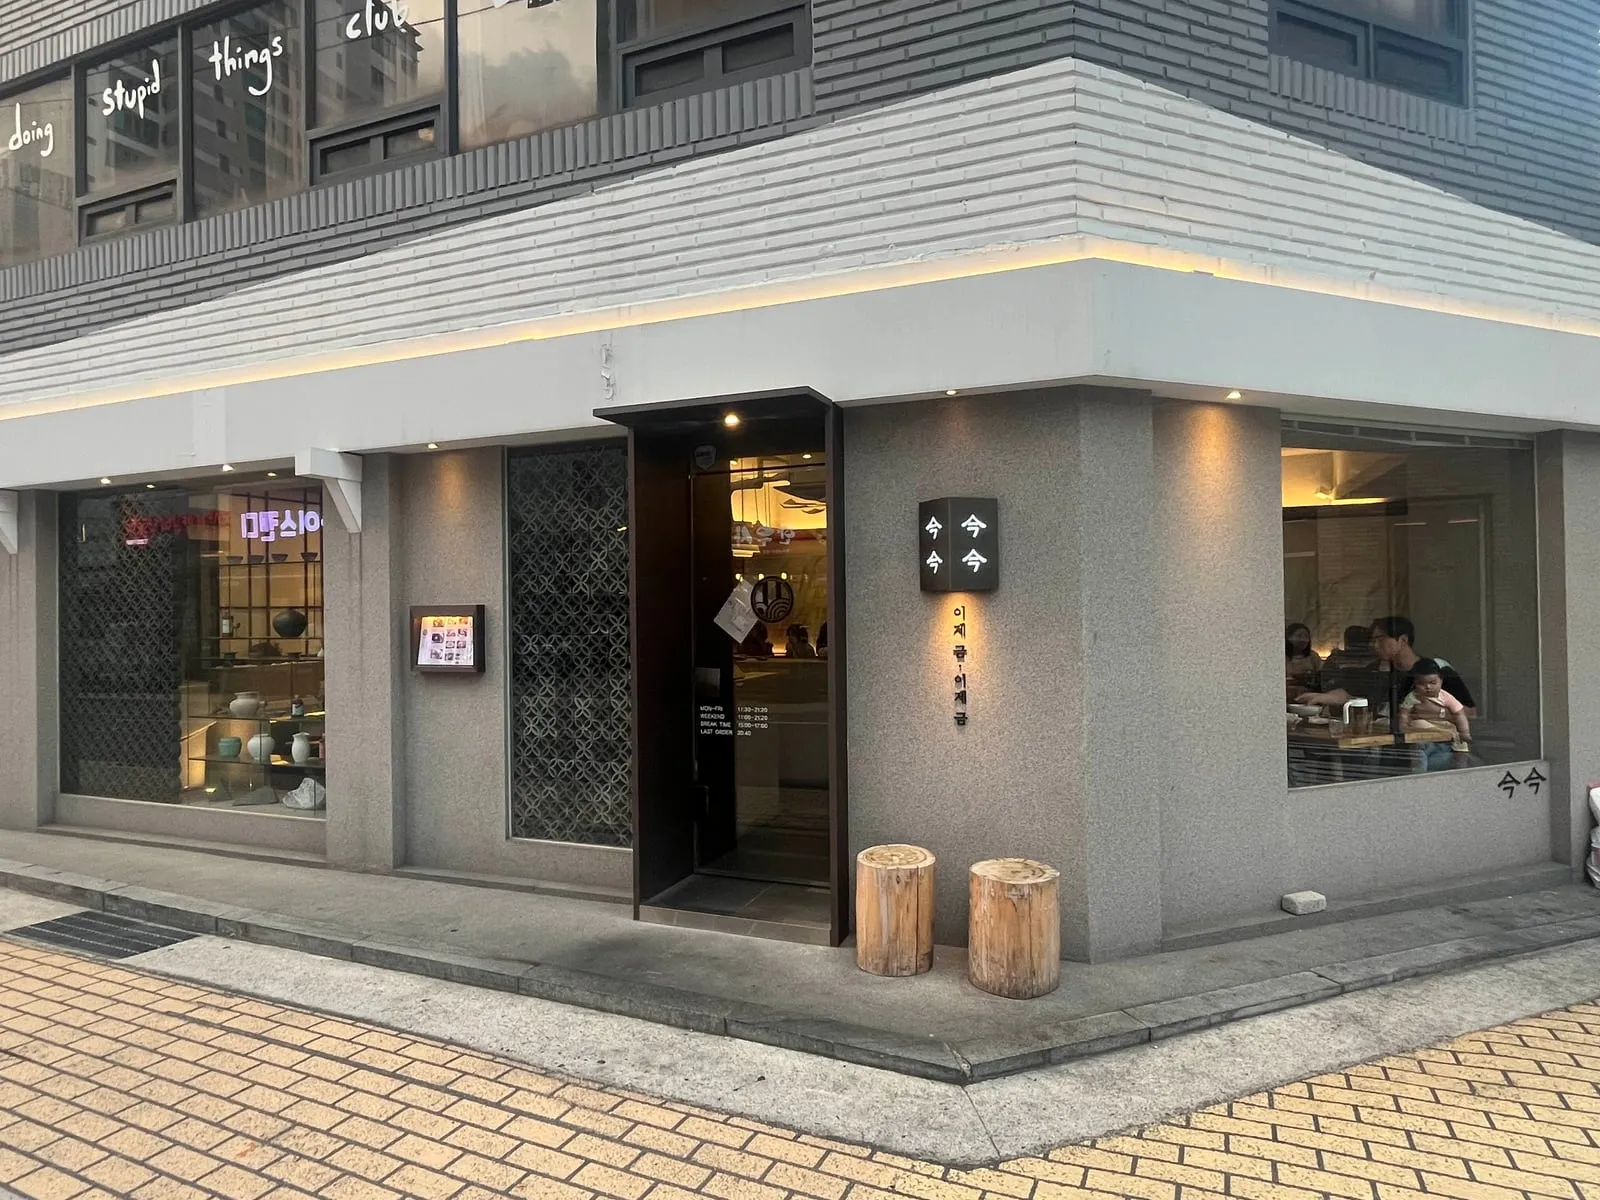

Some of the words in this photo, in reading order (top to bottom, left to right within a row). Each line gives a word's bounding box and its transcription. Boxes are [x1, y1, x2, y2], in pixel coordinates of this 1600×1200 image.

[9, 102, 54, 157] doing
[102, 59, 161, 119] stupid
[208, 35, 283, 96] things
[953, 673, 969, 727] 이제금
